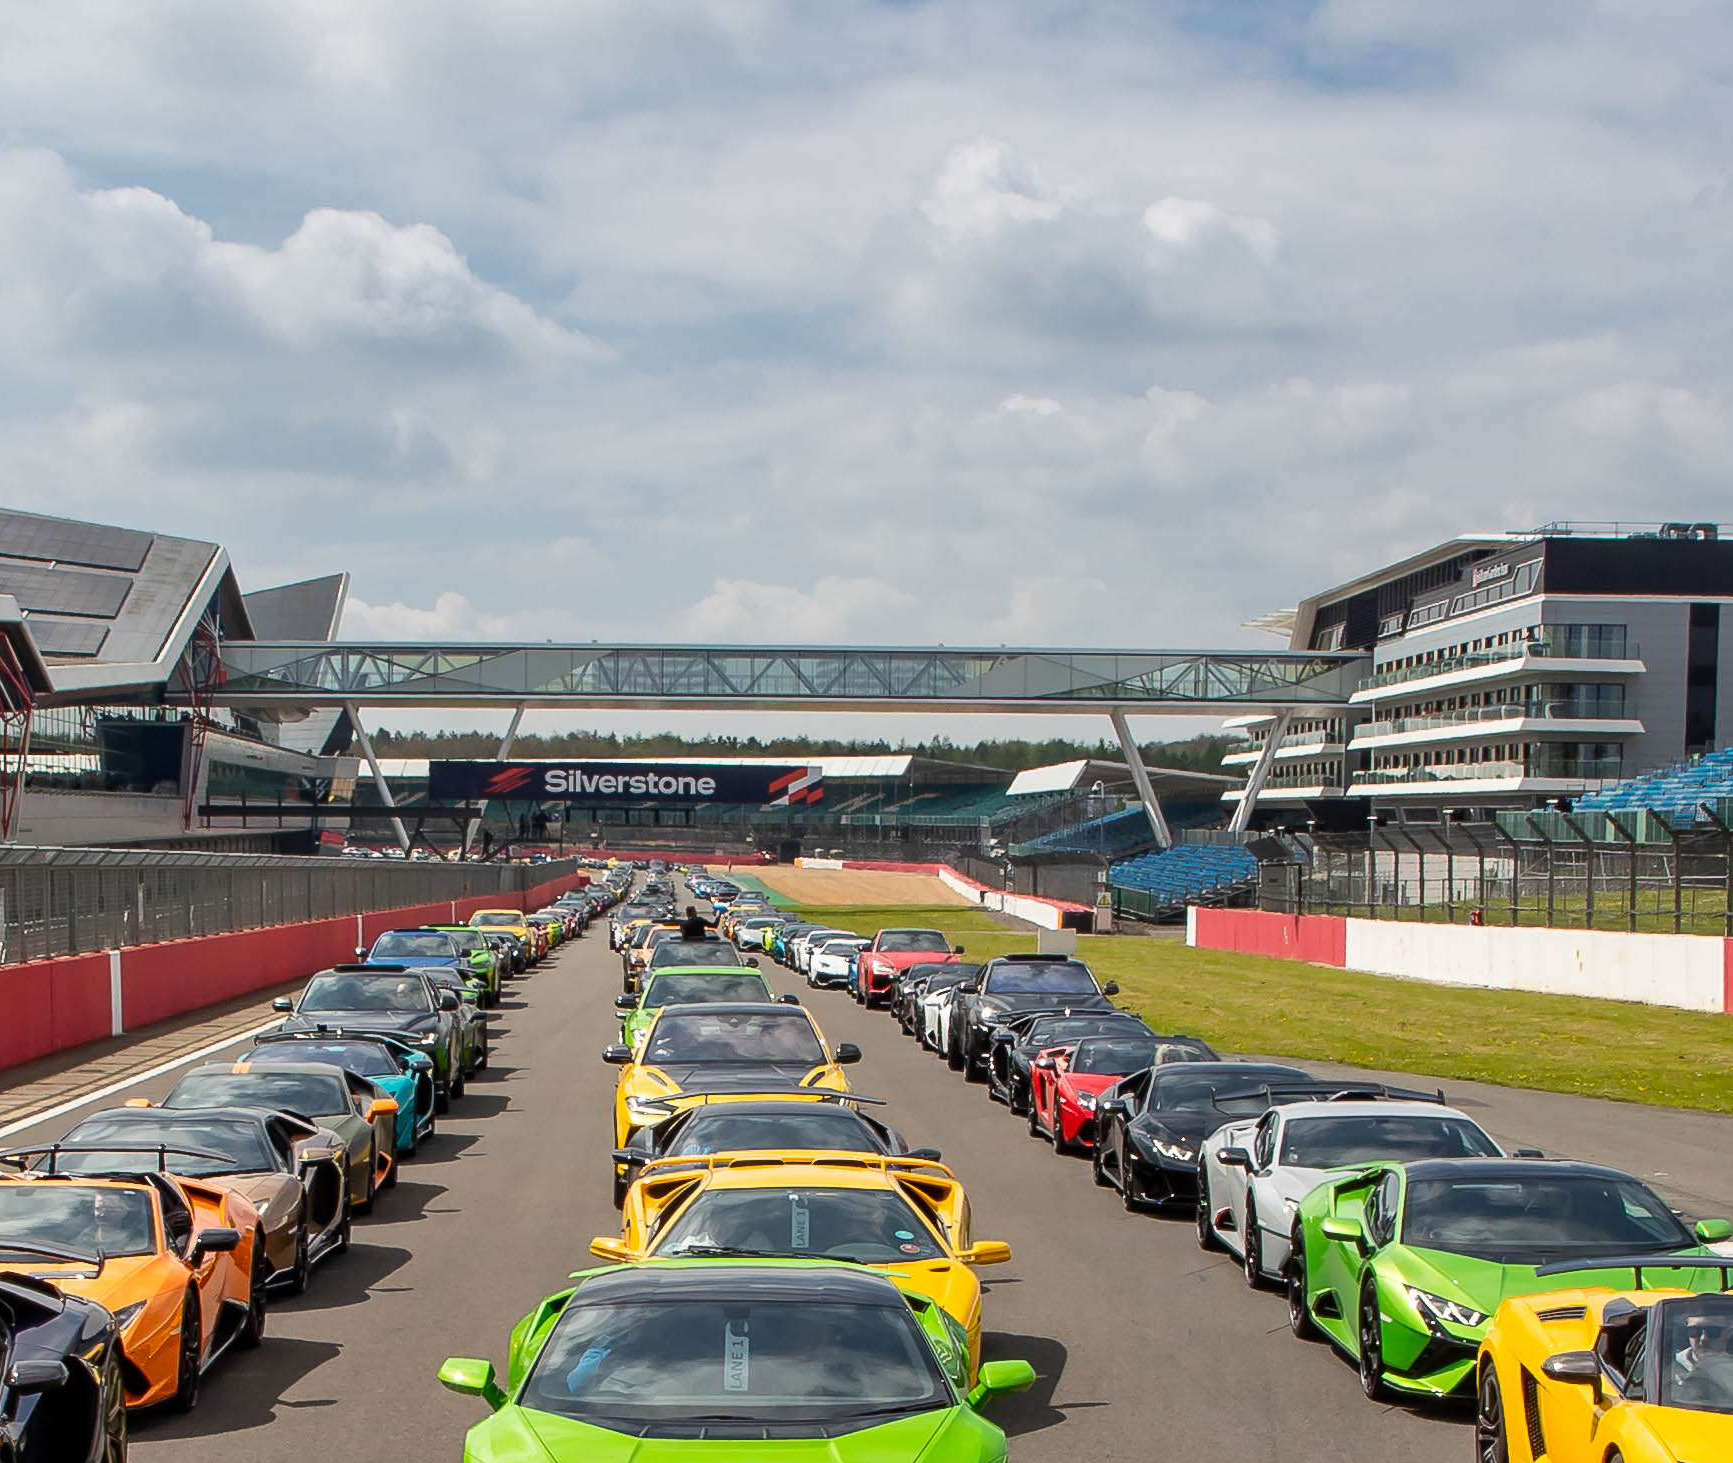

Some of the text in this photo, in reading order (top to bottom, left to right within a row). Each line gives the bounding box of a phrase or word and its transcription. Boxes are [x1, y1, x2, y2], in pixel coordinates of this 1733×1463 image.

[545, 770, 716, 795] Silverstone
[730, 1340, 744, 1389] LANE 1
